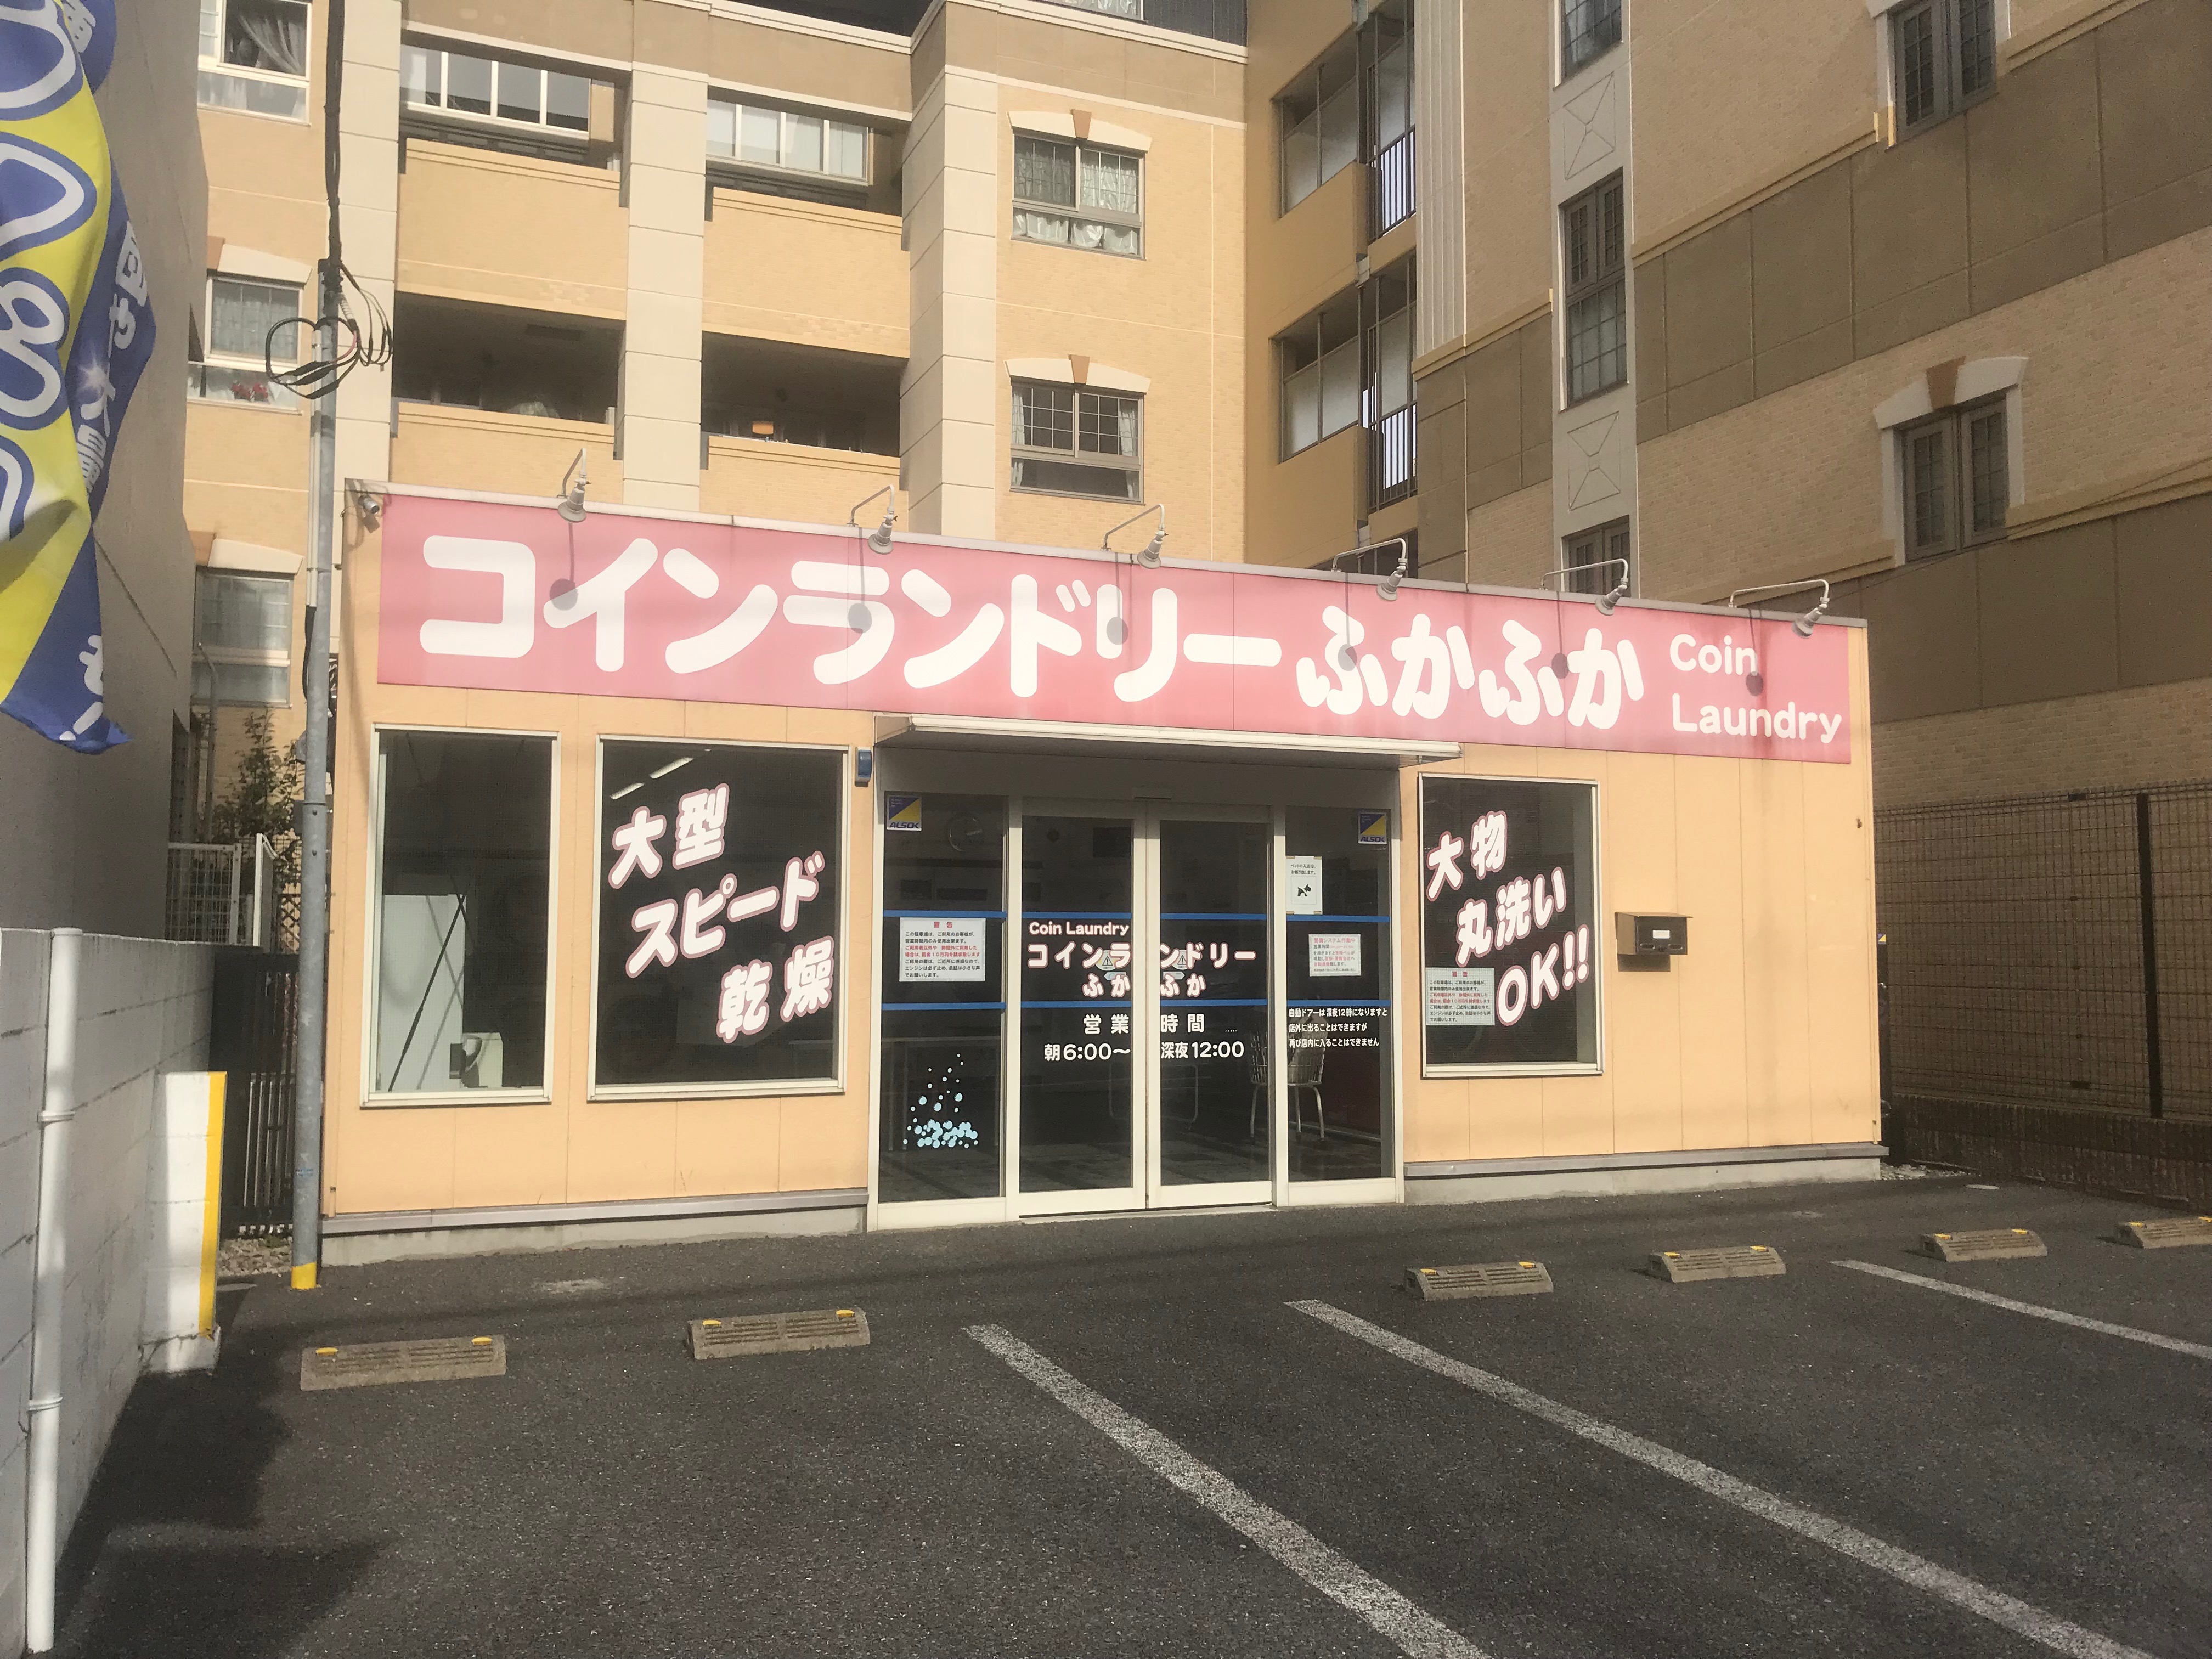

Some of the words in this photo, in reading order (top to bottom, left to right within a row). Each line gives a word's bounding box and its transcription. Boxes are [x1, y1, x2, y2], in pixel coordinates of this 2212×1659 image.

[420, 535, 1644, 730] コインランドリーふかふか
[1669, 634, 1757, 676] Coin
[1672, 693, 1842, 744] Laundry
[608, 783, 730, 889] 大型
[1427, 810, 1507, 901] 大物
[626, 851, 825, 978] スピード
[1029, 921, 1062, 935] Coin
[1066, 921, 1130, 936] Laundry
[1455, 866, 1566, 968] 丸洗い
[716, 936, 833, 1043] 乾燥
[1496, 924, 1589, 1026] OK!!
[1289, 1022, 1368, 1032] 店外に出ることはできますが
[1289, 1037, 1379, 1048] 再び店内に入ることはできません
